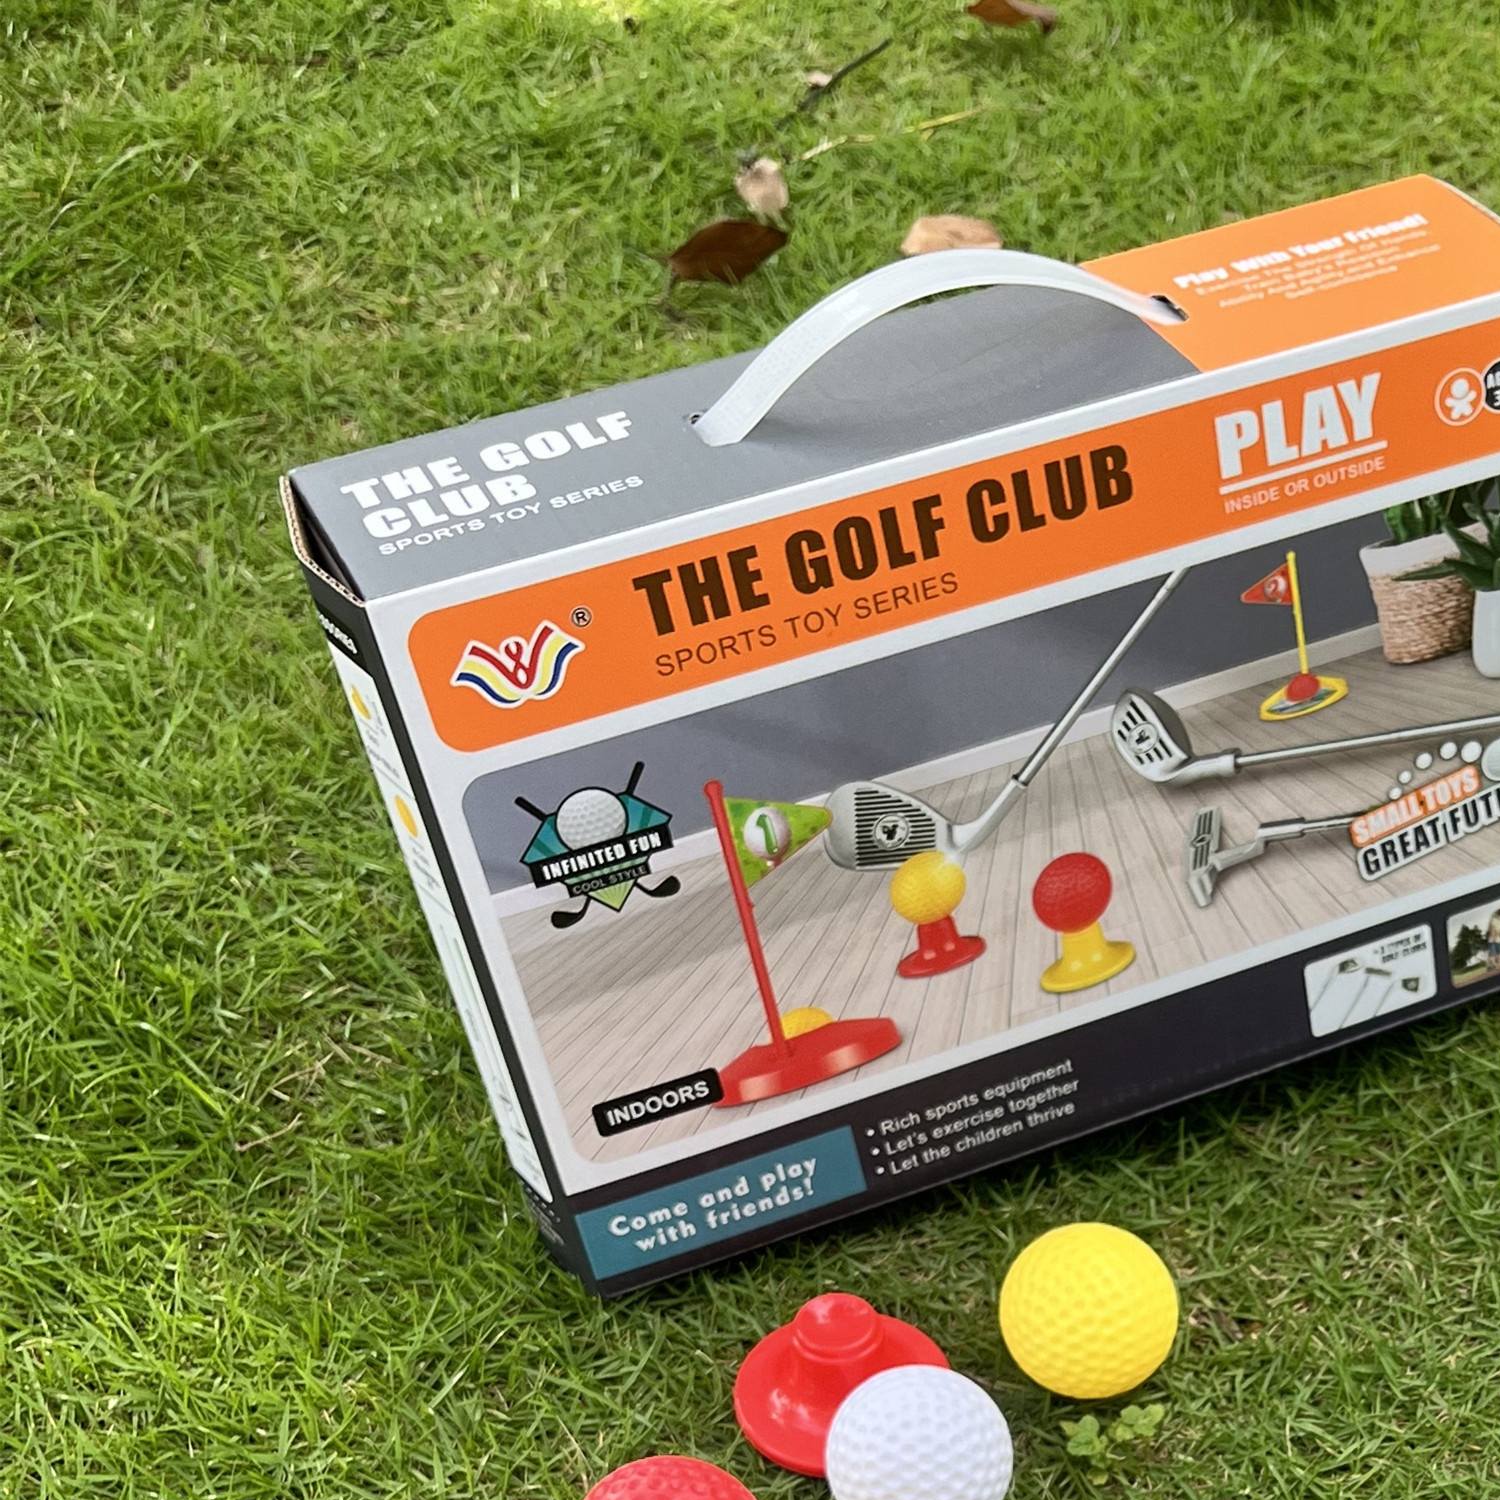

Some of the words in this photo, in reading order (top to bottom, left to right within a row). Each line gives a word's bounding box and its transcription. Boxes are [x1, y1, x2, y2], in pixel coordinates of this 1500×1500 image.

[1173, 267, 1228, 289] Play
[1231, 251, 1291, 273] With
[1287, 236, 1344, 258] Your
[340, 456, 471, 509] THE
[479, 411, 633, 472] GOLF
[1214, 372, 1382, 480] PLAY
[362, 474, 537, 539] CLUB
[378, 518, 486, 556] SPORTS
[489, 501, 542, 524] TOY
[549, 474, 645, 509] SERIES
[1223, 488, 1281, 515] INSIDE
[1284, 478, 1310, 498] OR
[1313, 456, 1386, 489] OUTSIDE
[632, 545, 769, 637] THE
[784, 494, 946, 595] GOLF
[965, 444, 1134, 544] CLUB
[655, 624, 777, 677] SPORTS
[785, 604, 842, 639] TOY
[856, 571, 959, 620] SERIES
[1352, 791, 1420, 843] SMALL
[1422, 771, 1477, 806] TOYS
[542, 843, 626, 881] INFINITED
[629, 832, 661, 855] FUN
[572, 878, 607, 895] COOL
[609, 866, 648, 884] STYLE
[1363, 817, 1440, 876] GREAT
[606, 1080, 710, 1126] INDOORS
[880, 1112, 920, 1136] Rich
[924, 1092, 979, 1121] sports
[983, 1058, 1074, 1101] equipment
[884, 1132, 928, 1156] Let's
[932, 1104, 1005, 1140] exercise
[1008, 1078, 1079, 1114] together
[889, 1154, 919, 1175] Let
[922, 1144, 950, 1164] the
[954, 1119, 1023, 1153] children
[1025, 1101, 1076, 1128] thrive
[609, 1201, 689, 1236] Come
[699, 1175, 750, 1208] and
[759, 1158, 816, 1192] play
[636, 1220, 697, 1252] with
[706, 1177, 814, 1230] friends!
